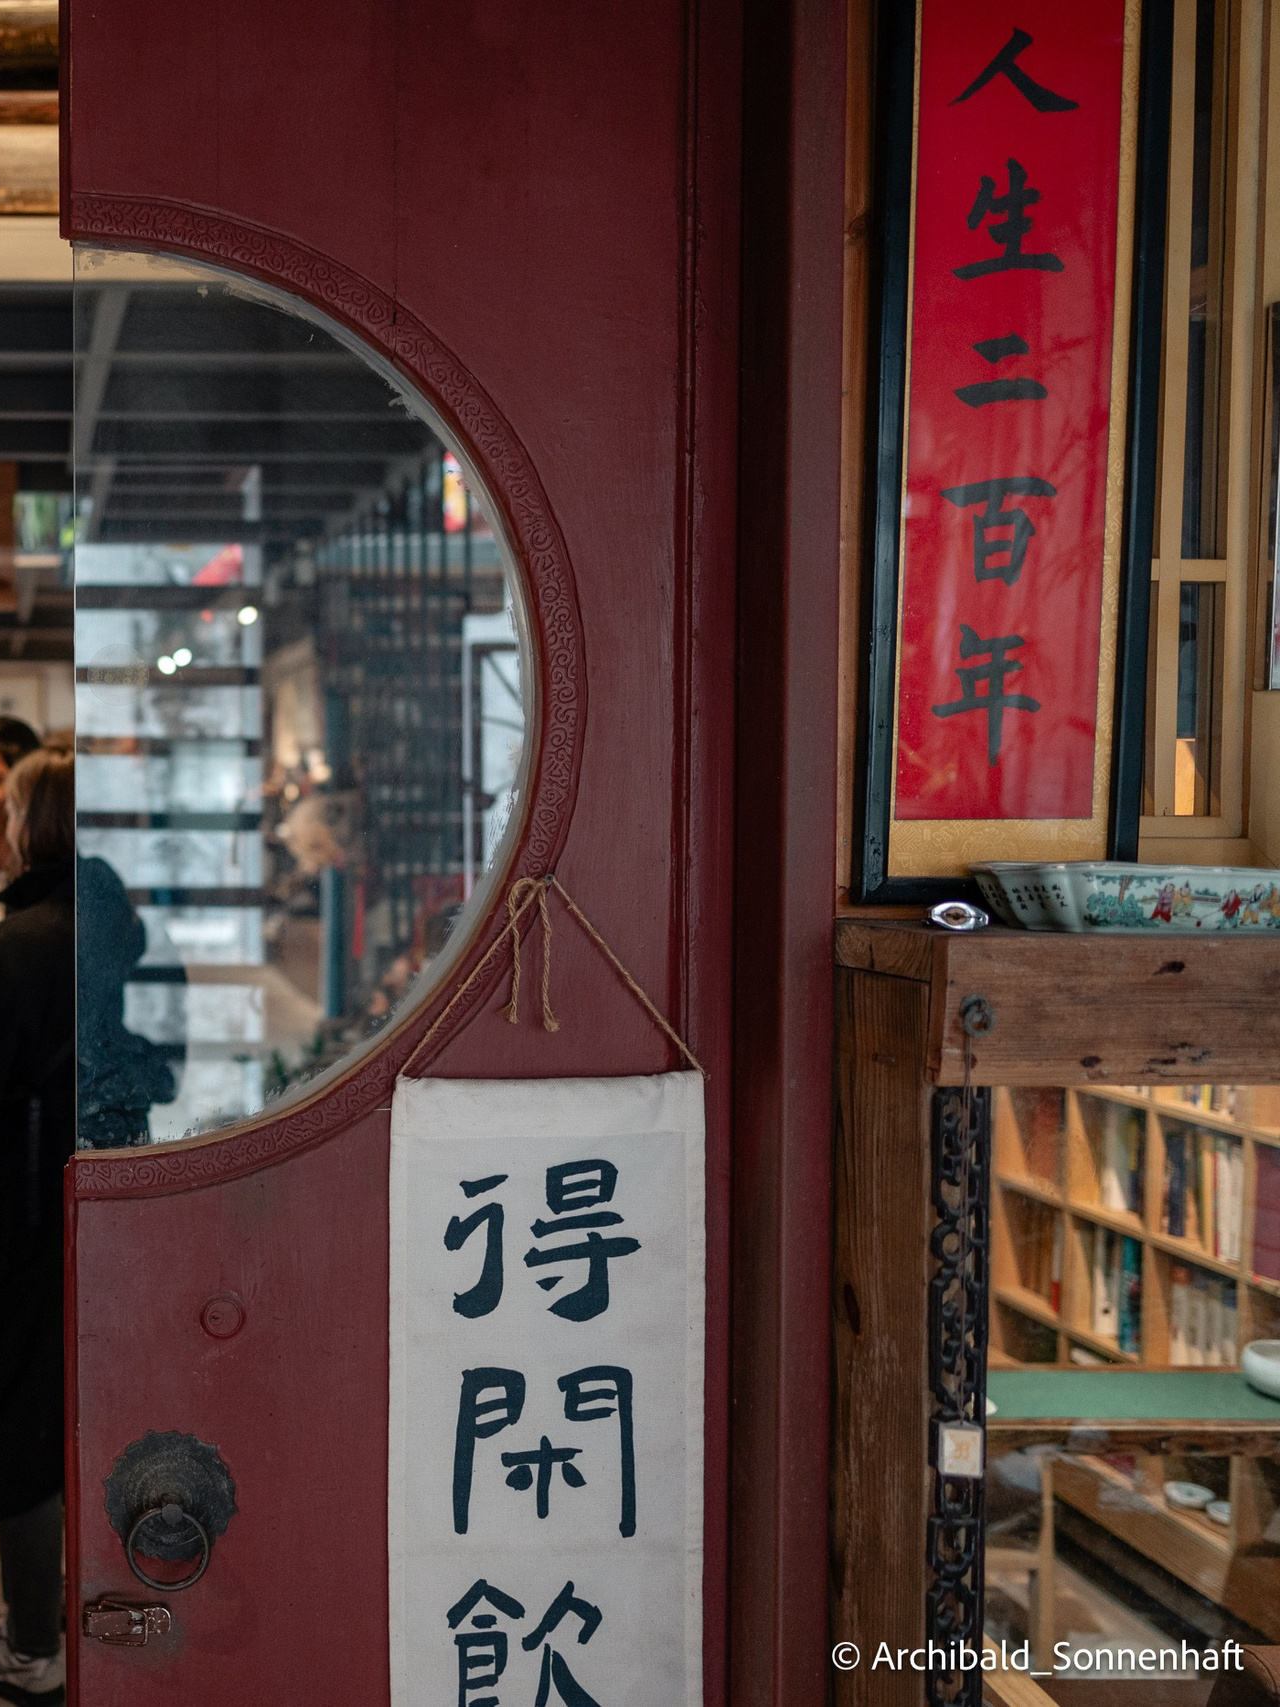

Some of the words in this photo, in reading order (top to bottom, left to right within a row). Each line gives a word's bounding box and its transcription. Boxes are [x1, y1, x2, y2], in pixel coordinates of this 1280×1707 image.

[932, 27, 1080, 767] 人生二百年
